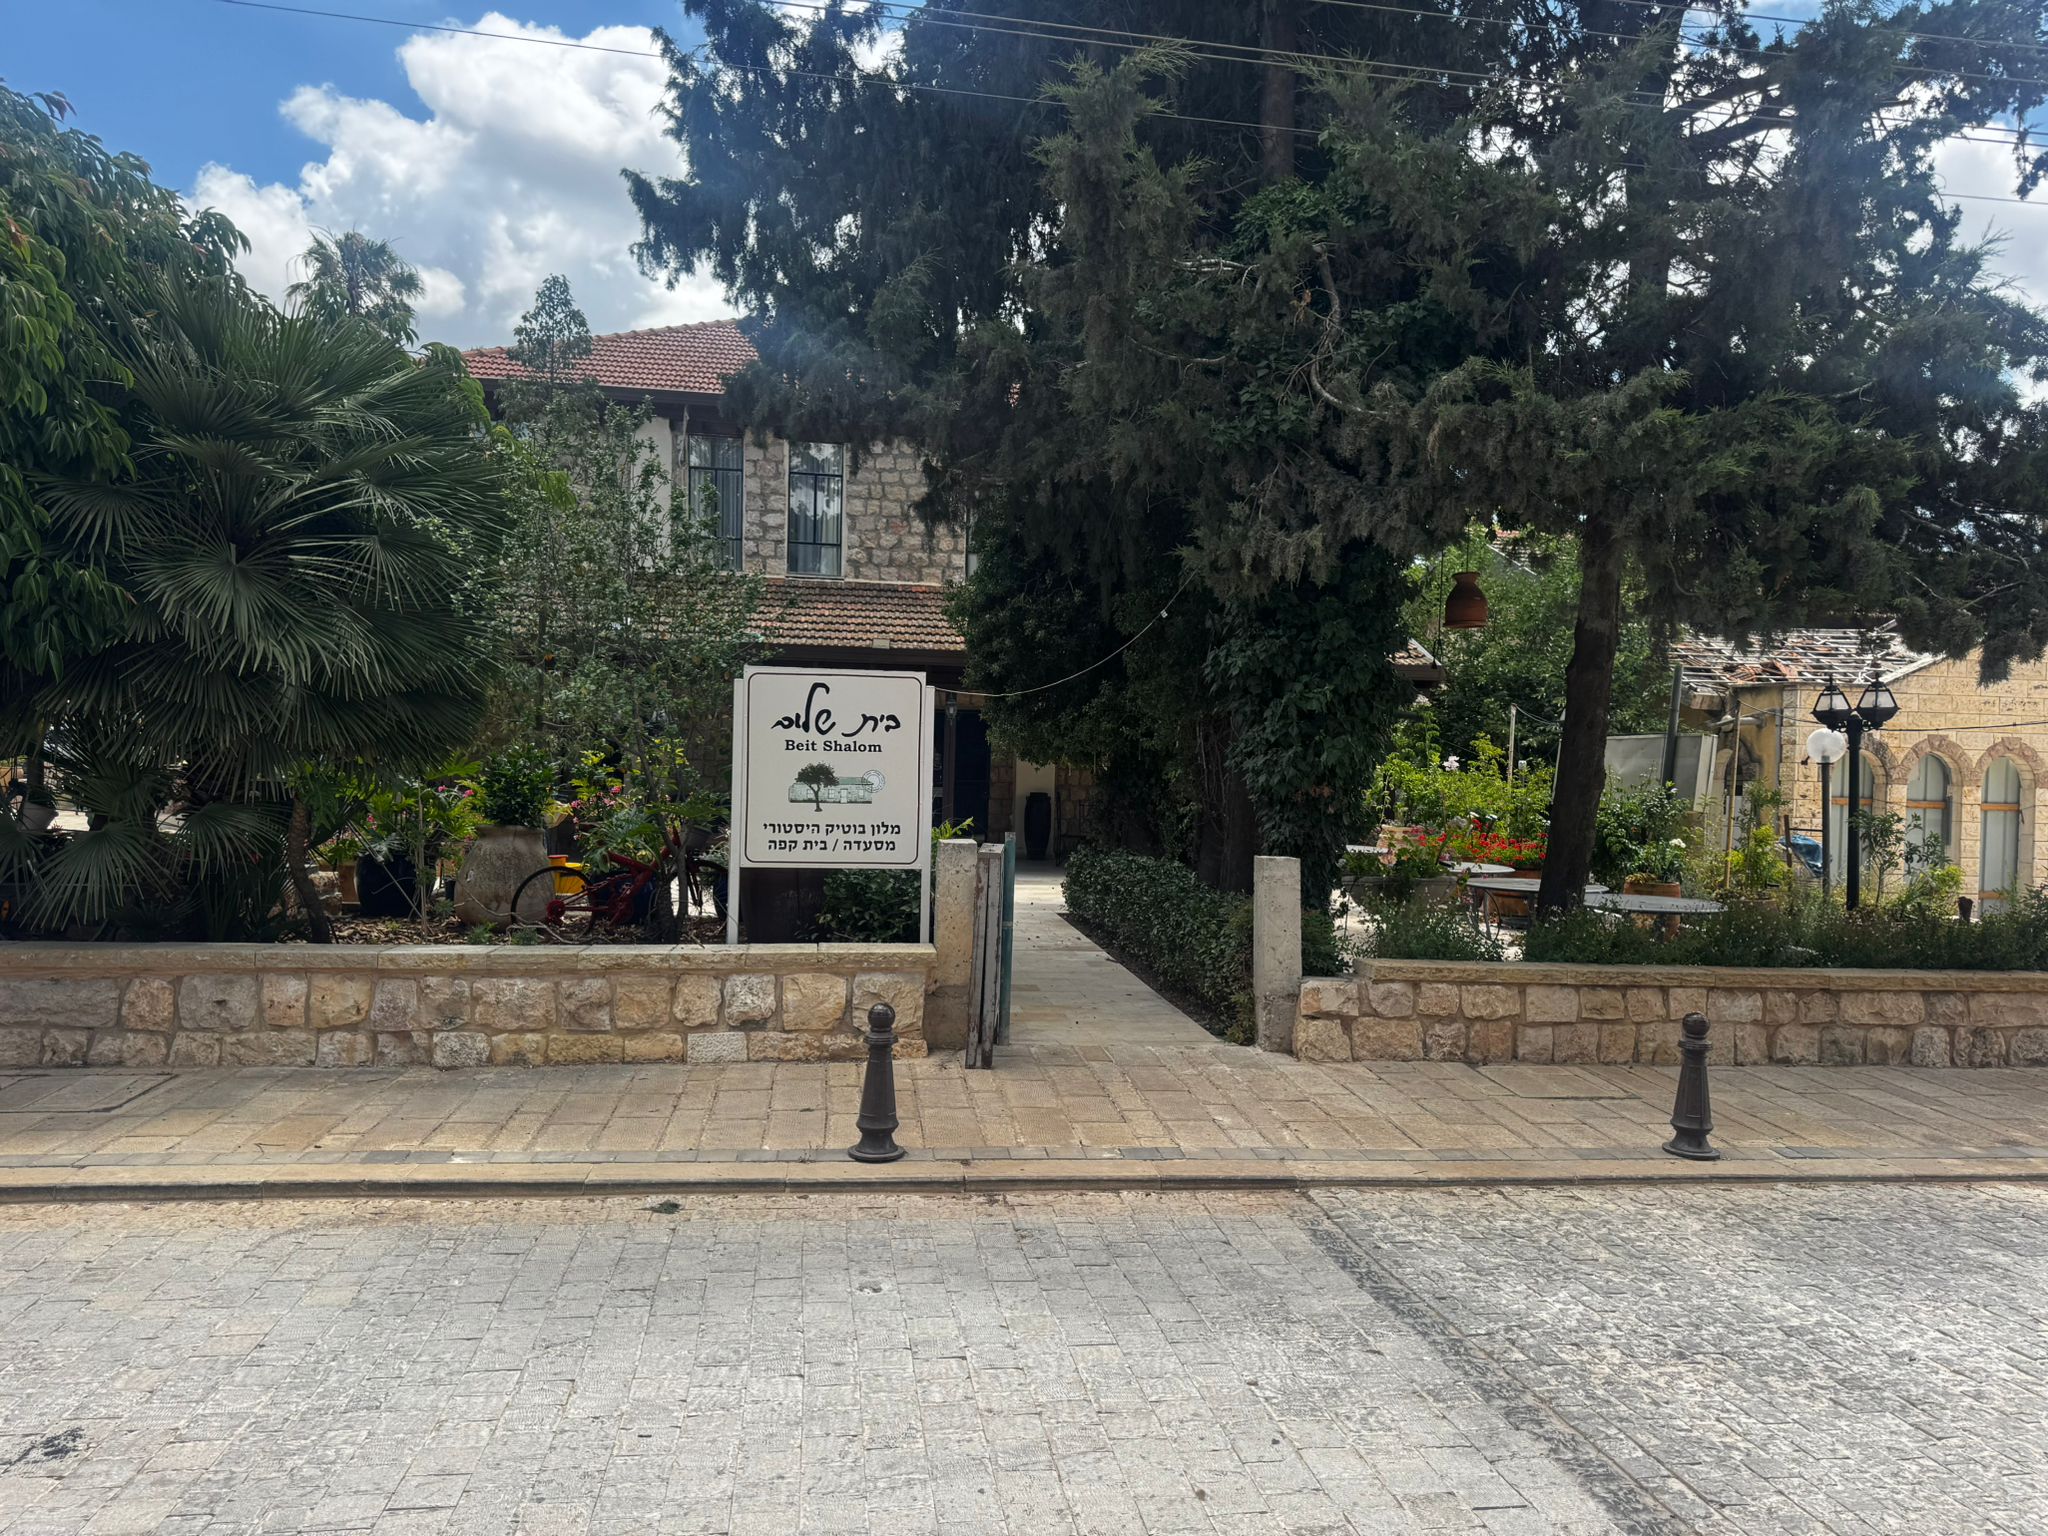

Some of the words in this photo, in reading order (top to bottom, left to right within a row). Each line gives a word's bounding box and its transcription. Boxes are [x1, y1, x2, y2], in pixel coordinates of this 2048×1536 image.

[771, 682, 836, 735] שלום
[842, 714, 901, 737] בית
[785, 740, 817, 751] Beit
[823, 740, 882, 752] Shalom
[763, 823, 820, 834] היסטורי
[826, 824, 866, 836] בוטיק
[871, 822, 900, 836] מלון
[768, 840, 798, 852] קפה
[803, 840, 827, 850] בית
[832, 839, 838, 852] /
[844, 841, 895, 851] מסעדה
